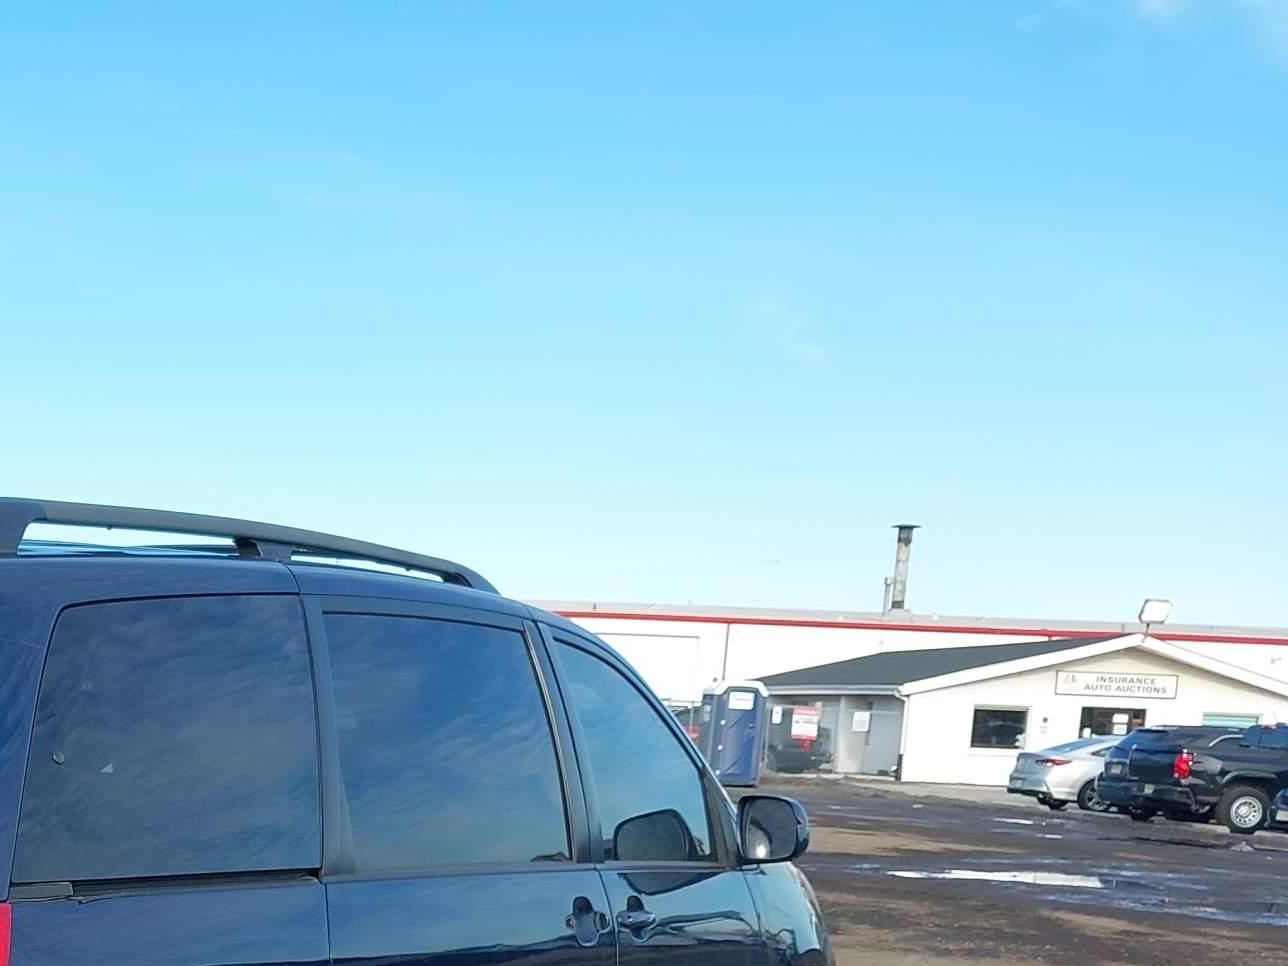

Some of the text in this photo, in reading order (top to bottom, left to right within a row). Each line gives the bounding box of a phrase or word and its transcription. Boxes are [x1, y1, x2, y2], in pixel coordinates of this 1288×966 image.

[1096, 676, 1156, 685] INSURANCE
[1083, 683, 1167, 694] AUTO AUCTIONS
